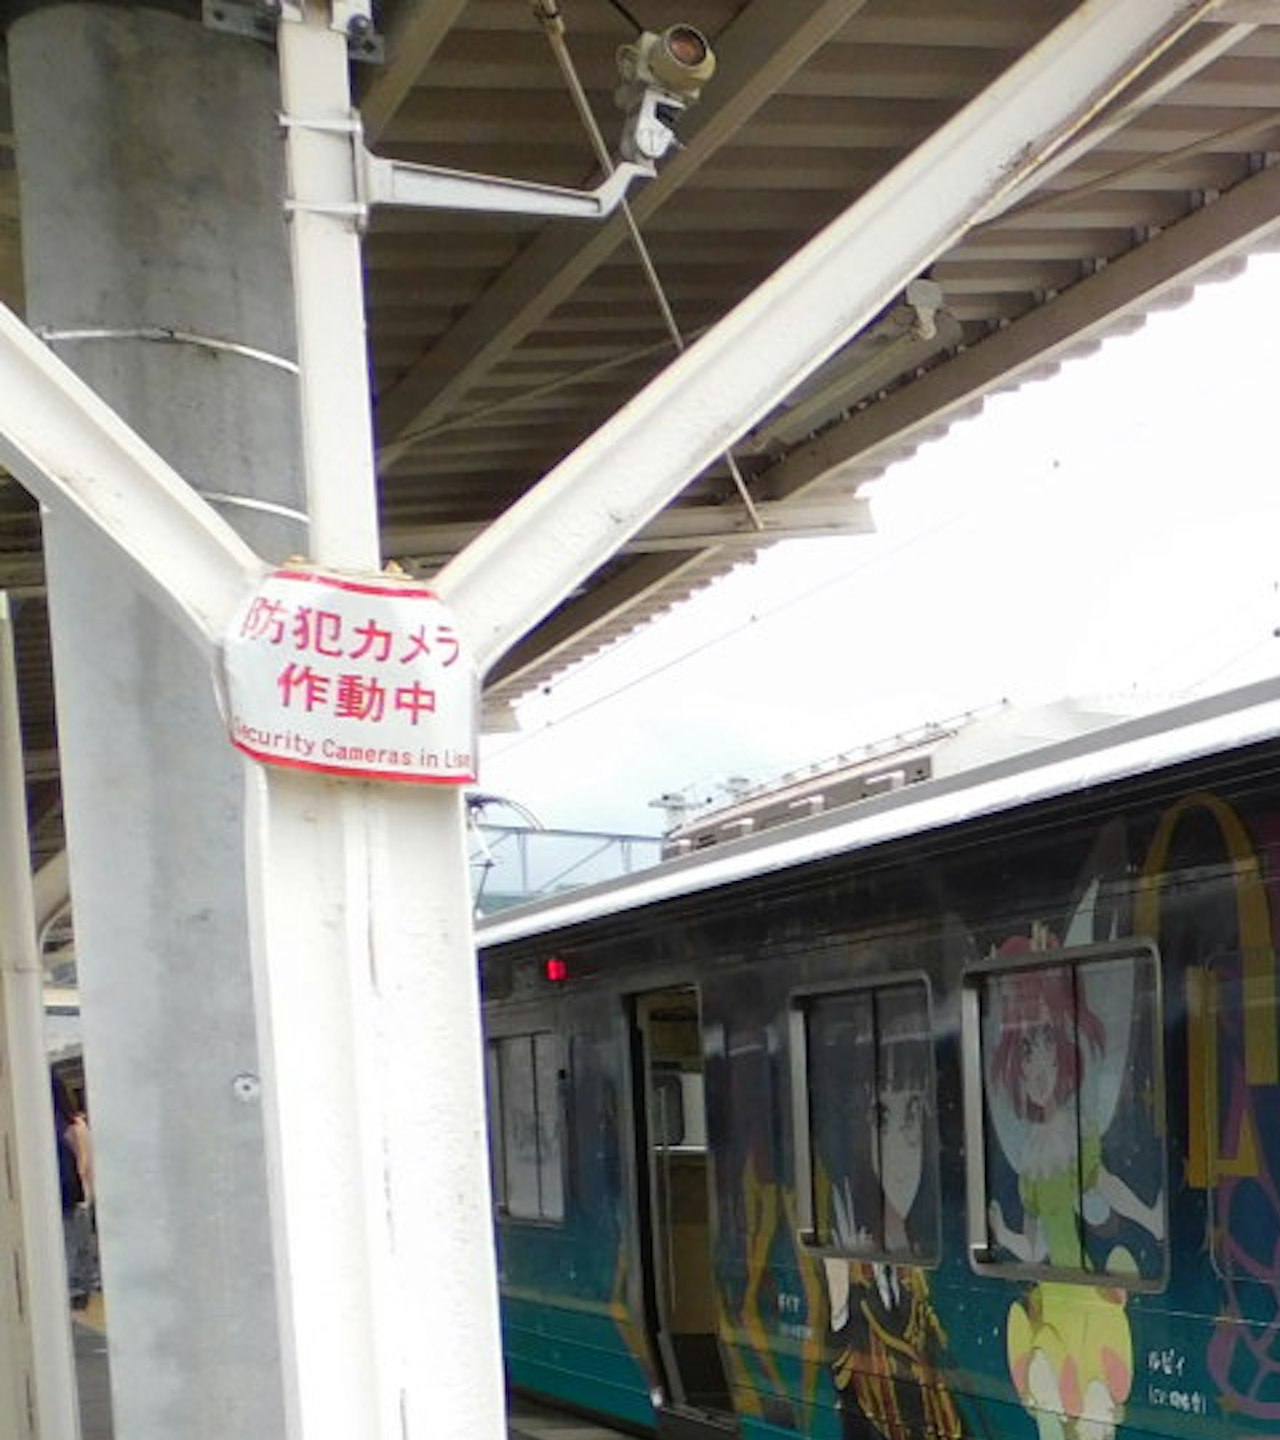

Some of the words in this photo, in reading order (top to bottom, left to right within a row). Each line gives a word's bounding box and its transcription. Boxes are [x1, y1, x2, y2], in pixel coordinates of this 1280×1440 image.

[240, 596, 460, 668] 防犯カメラ
[278, 662, 436, 725] 作動中
[321, 738, 412, 768] Cameras
[420, 748, 438, 769] in
